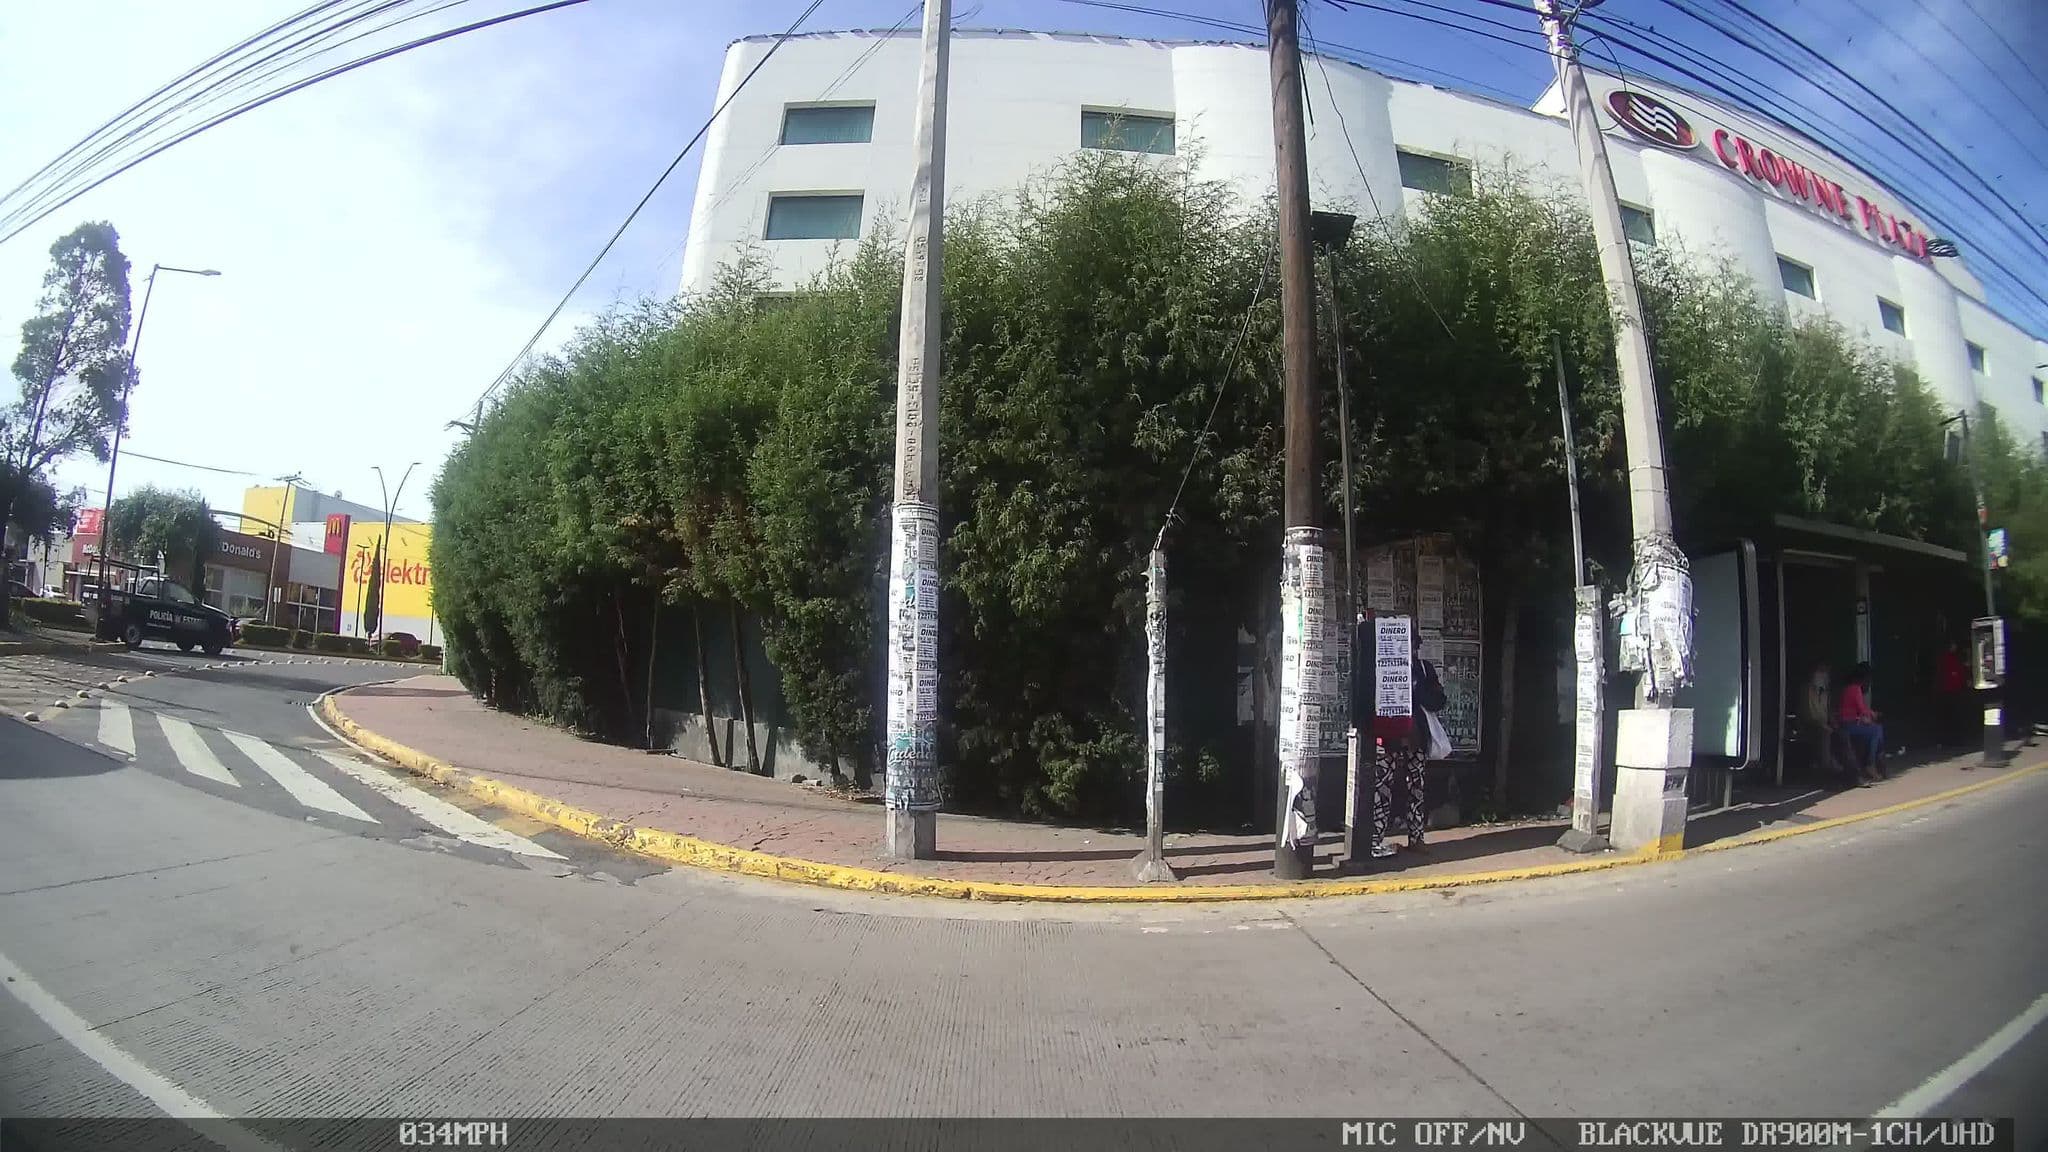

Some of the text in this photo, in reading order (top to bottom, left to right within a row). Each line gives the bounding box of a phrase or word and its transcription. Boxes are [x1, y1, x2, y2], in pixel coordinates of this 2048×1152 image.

[1712, 129, 1851, 220] CROWNE
[222, 541, 262, 559] Donald's
[380, 558, 432, 585] lektr
[1382, 675, 1408, 683] DINERO
